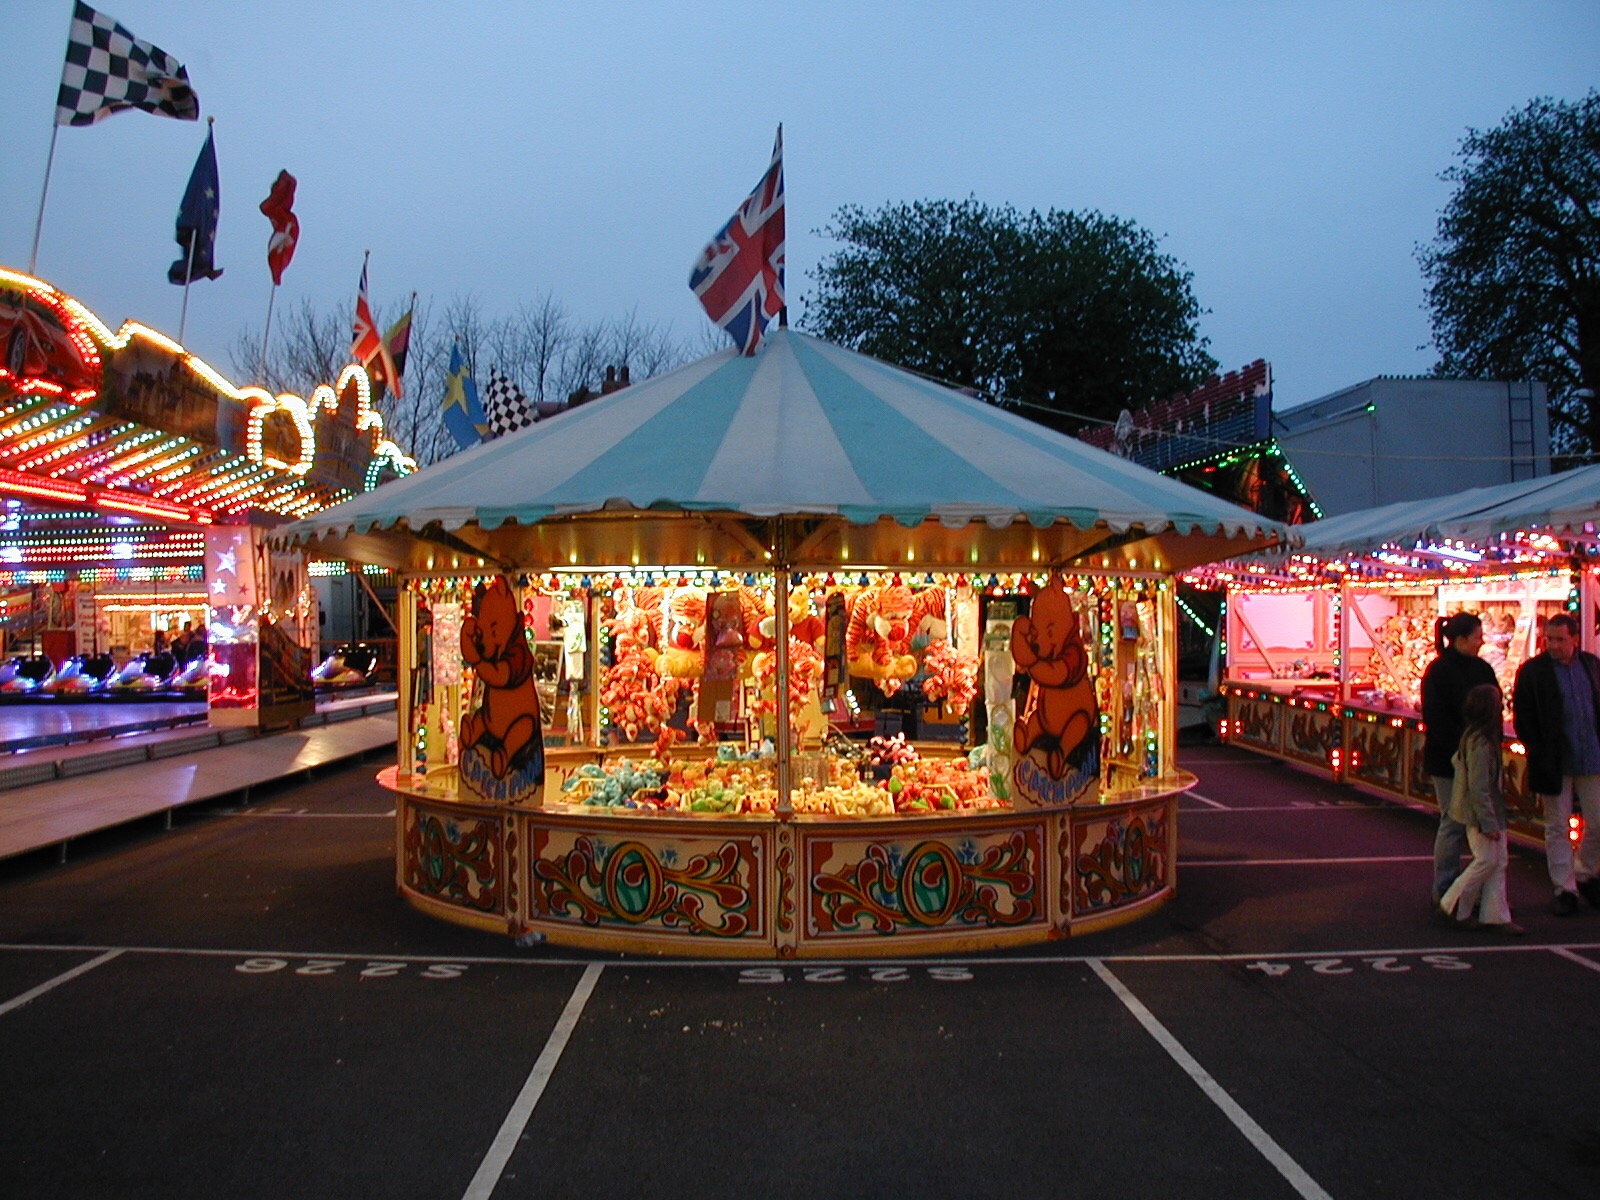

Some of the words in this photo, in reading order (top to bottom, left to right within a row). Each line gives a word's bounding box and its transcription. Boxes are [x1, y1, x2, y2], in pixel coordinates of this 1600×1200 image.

[234, 959, 469, 979] S226
[1244, 956, 1472, 974] S224
[738, 966, 974, 983] S225
